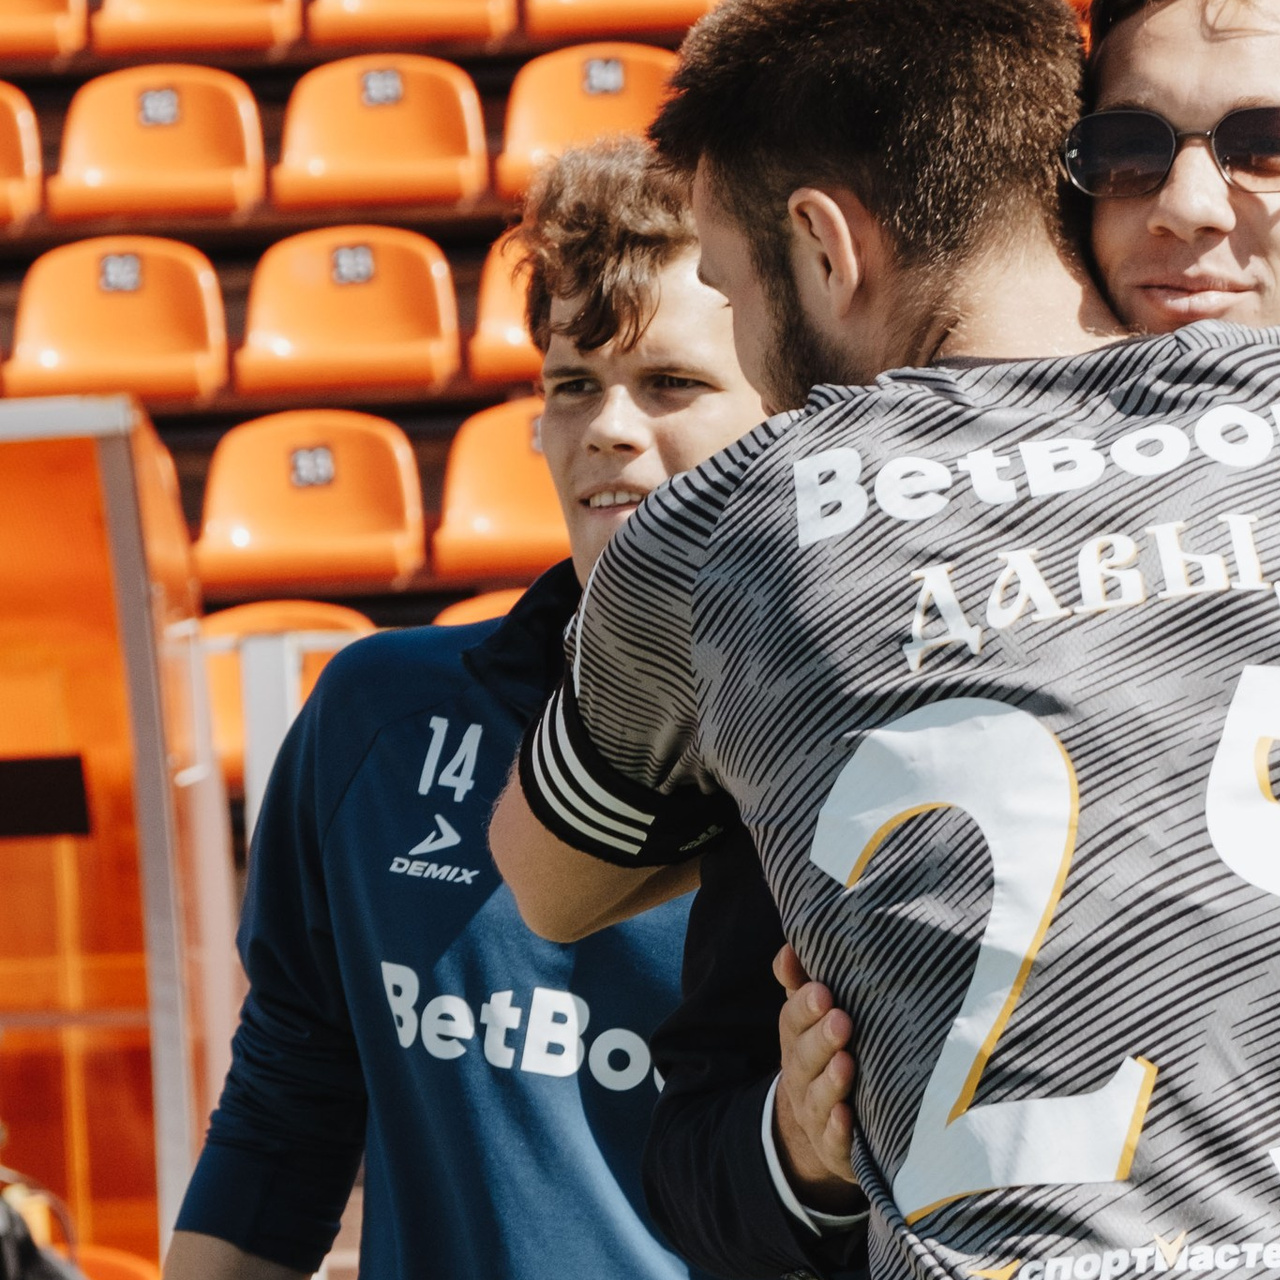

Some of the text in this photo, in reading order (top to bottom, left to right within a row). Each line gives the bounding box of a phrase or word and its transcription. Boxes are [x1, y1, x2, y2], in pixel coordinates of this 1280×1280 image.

[417, 715, 483, 803] 14
[388, 855, 481, 886] DEMIX
[380, 959, 666, 1095] BetBo
